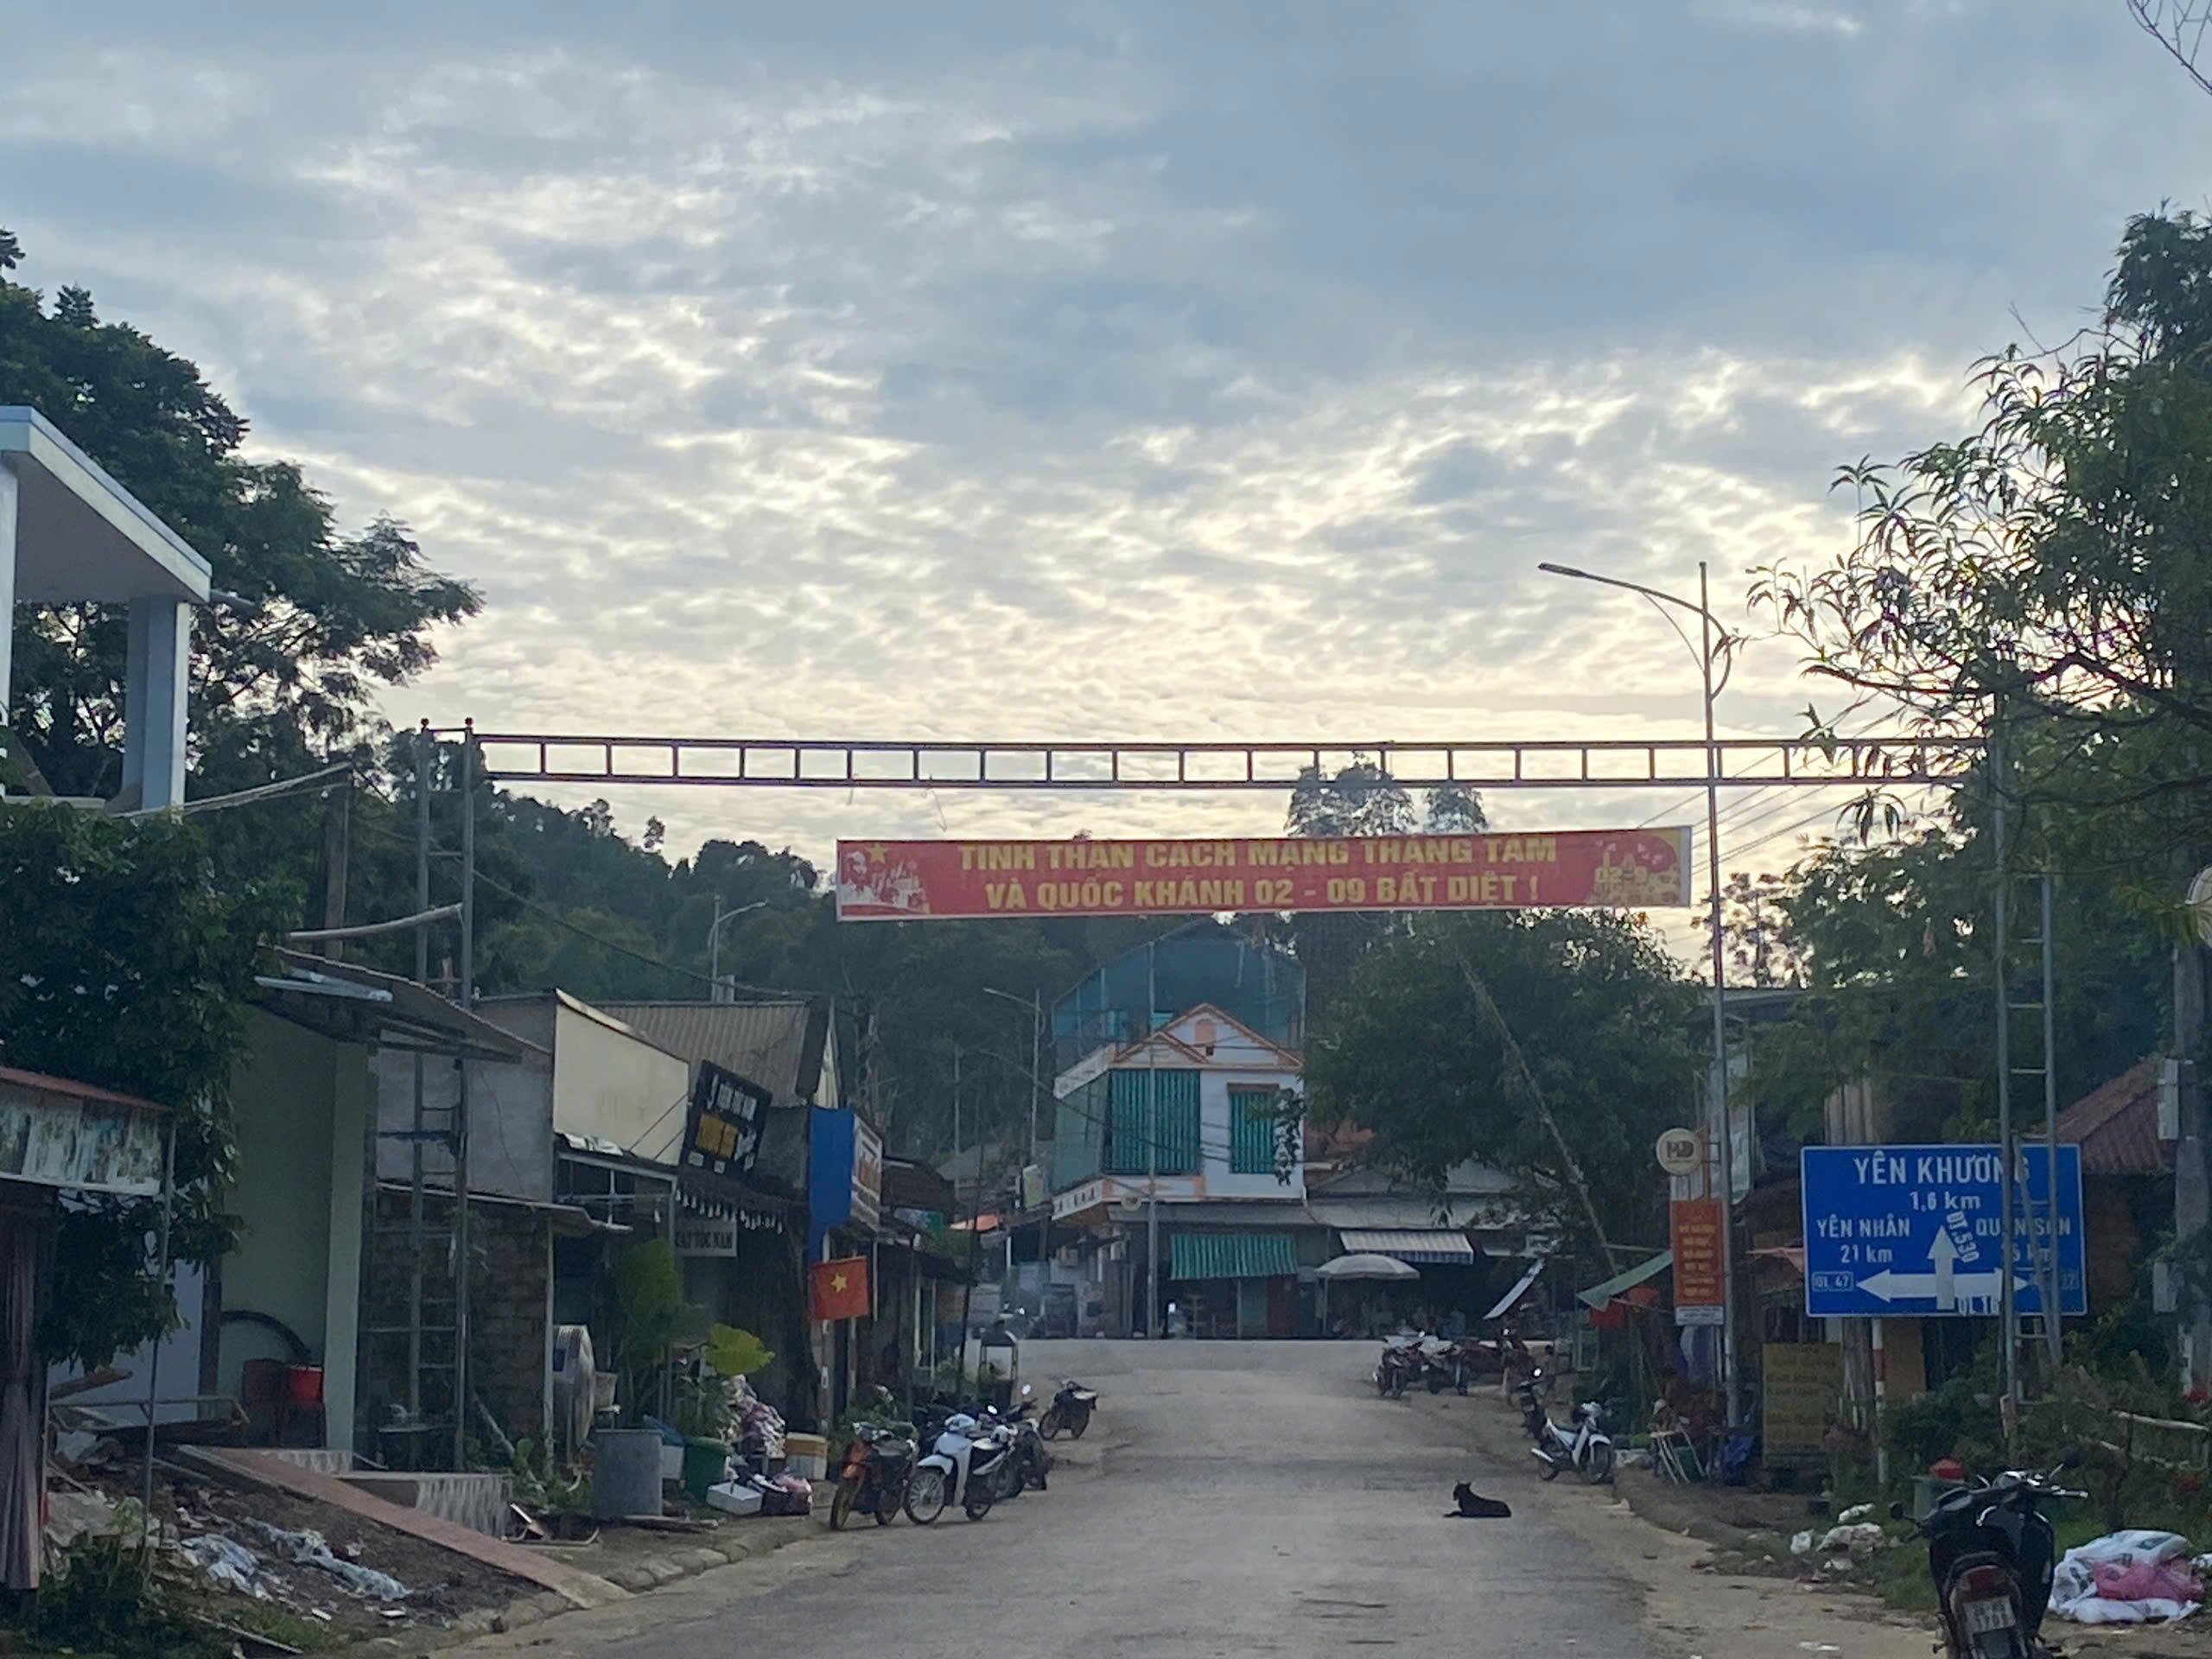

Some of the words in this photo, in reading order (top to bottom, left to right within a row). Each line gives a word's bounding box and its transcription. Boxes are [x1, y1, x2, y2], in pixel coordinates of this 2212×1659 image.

[985, 877, 1027, 910] VÀ
[1038, 873, 1124, 910] QUỐC
[1134, 874, 1245, 906] KHÁNH
[1254, 879, 1294, 905] 02
[1326, 877, 1366, 904] 09
[1376, 868, 1439, 904] BẤT
[1447, 870, 1517, 907] DIỆT
[1529, 875, 1538, 901] !
[1853, 1150, 1907, 1185] YÊN
[1944, 1191, 1981, 1210] km
[1816, 1213, 1853, 1238] YÊN
[1859, 1213, 1910, 1237] NHÂN
[1840, 1243, 1859, 1263] 21
[1866, 1243, 1893, 1263] km
